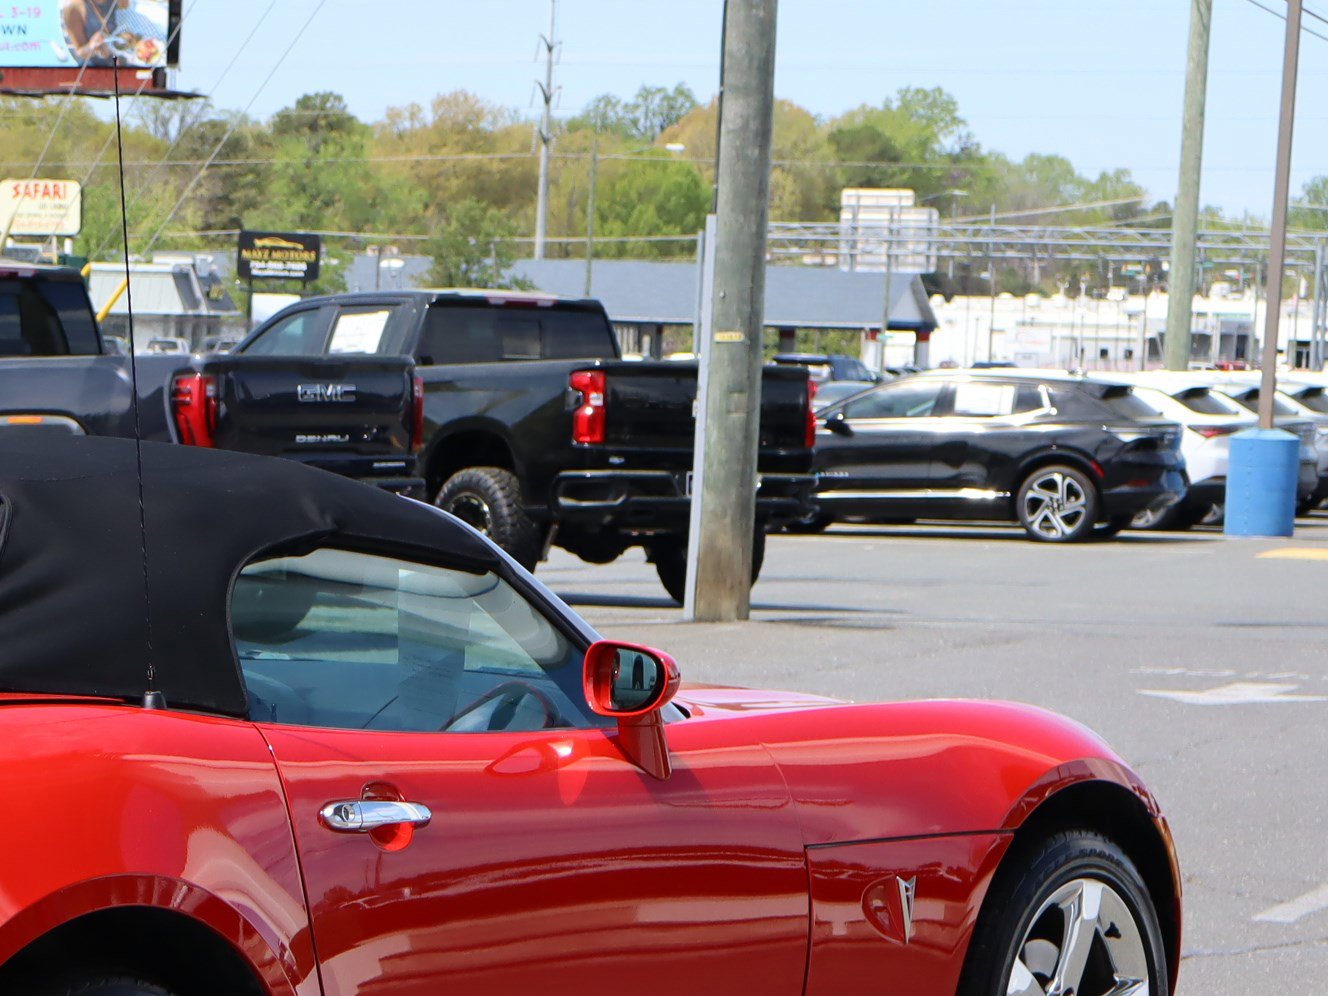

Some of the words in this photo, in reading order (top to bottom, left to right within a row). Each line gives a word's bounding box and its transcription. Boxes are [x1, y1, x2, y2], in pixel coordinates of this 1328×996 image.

[10, 7, 41, 19] 3-19
[13, 183, 67, 200] SAFARI
[271, 249, 317, 262] MOTORS
[297, 384, 357, 402] GMC
[295, 434, 350, 443] DENALI
